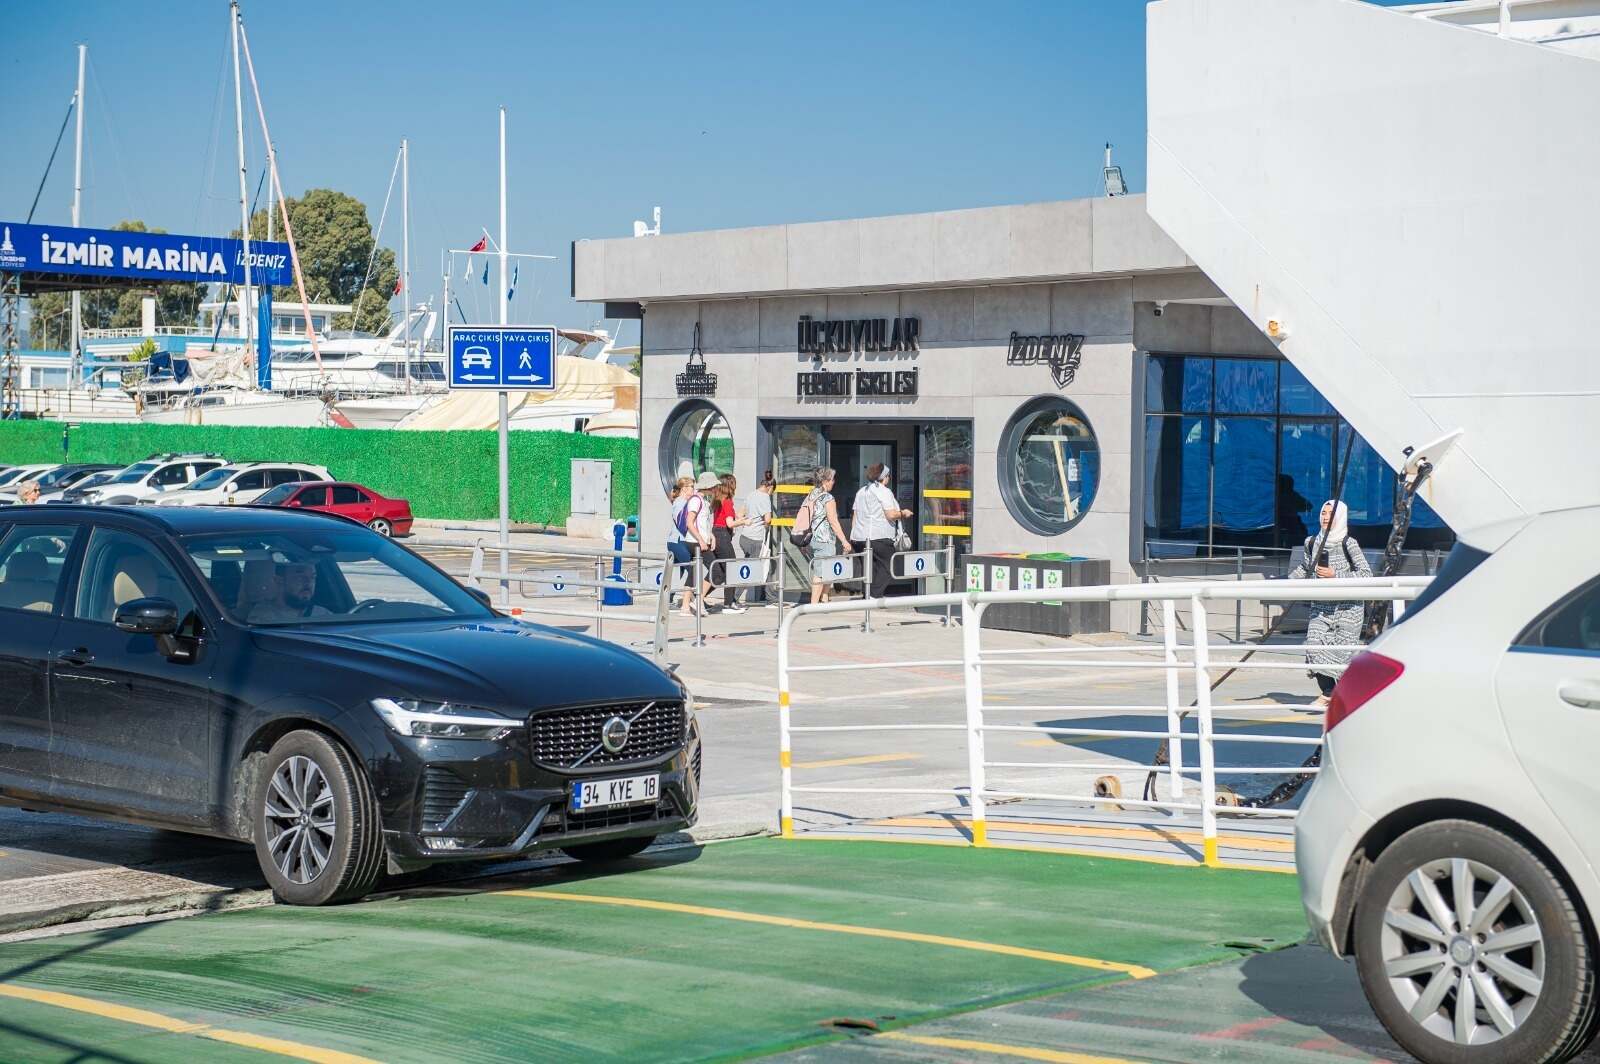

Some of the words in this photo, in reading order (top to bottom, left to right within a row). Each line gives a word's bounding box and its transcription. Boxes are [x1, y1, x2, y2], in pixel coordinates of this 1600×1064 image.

[42, 233, 114, 268] İZMİR
[122, 242, 227, 275] MARİNA
[453, 334, 476, 343] ARAÇ
[478, 334, 500, 344] ÇIKIŞ
[527, 335, 550, 344] ÇIKIŞ
[797, 315, 920, 361] ÜÇKUYULAR
[1007, 331, 1084, 366] İZDENİZ
[856, 367, 918, 396] İSKELESİ
[584, 784, 599, 804] 34
[610, 780, 633, 801] KYE
[644, 777, 656, 797] 18
